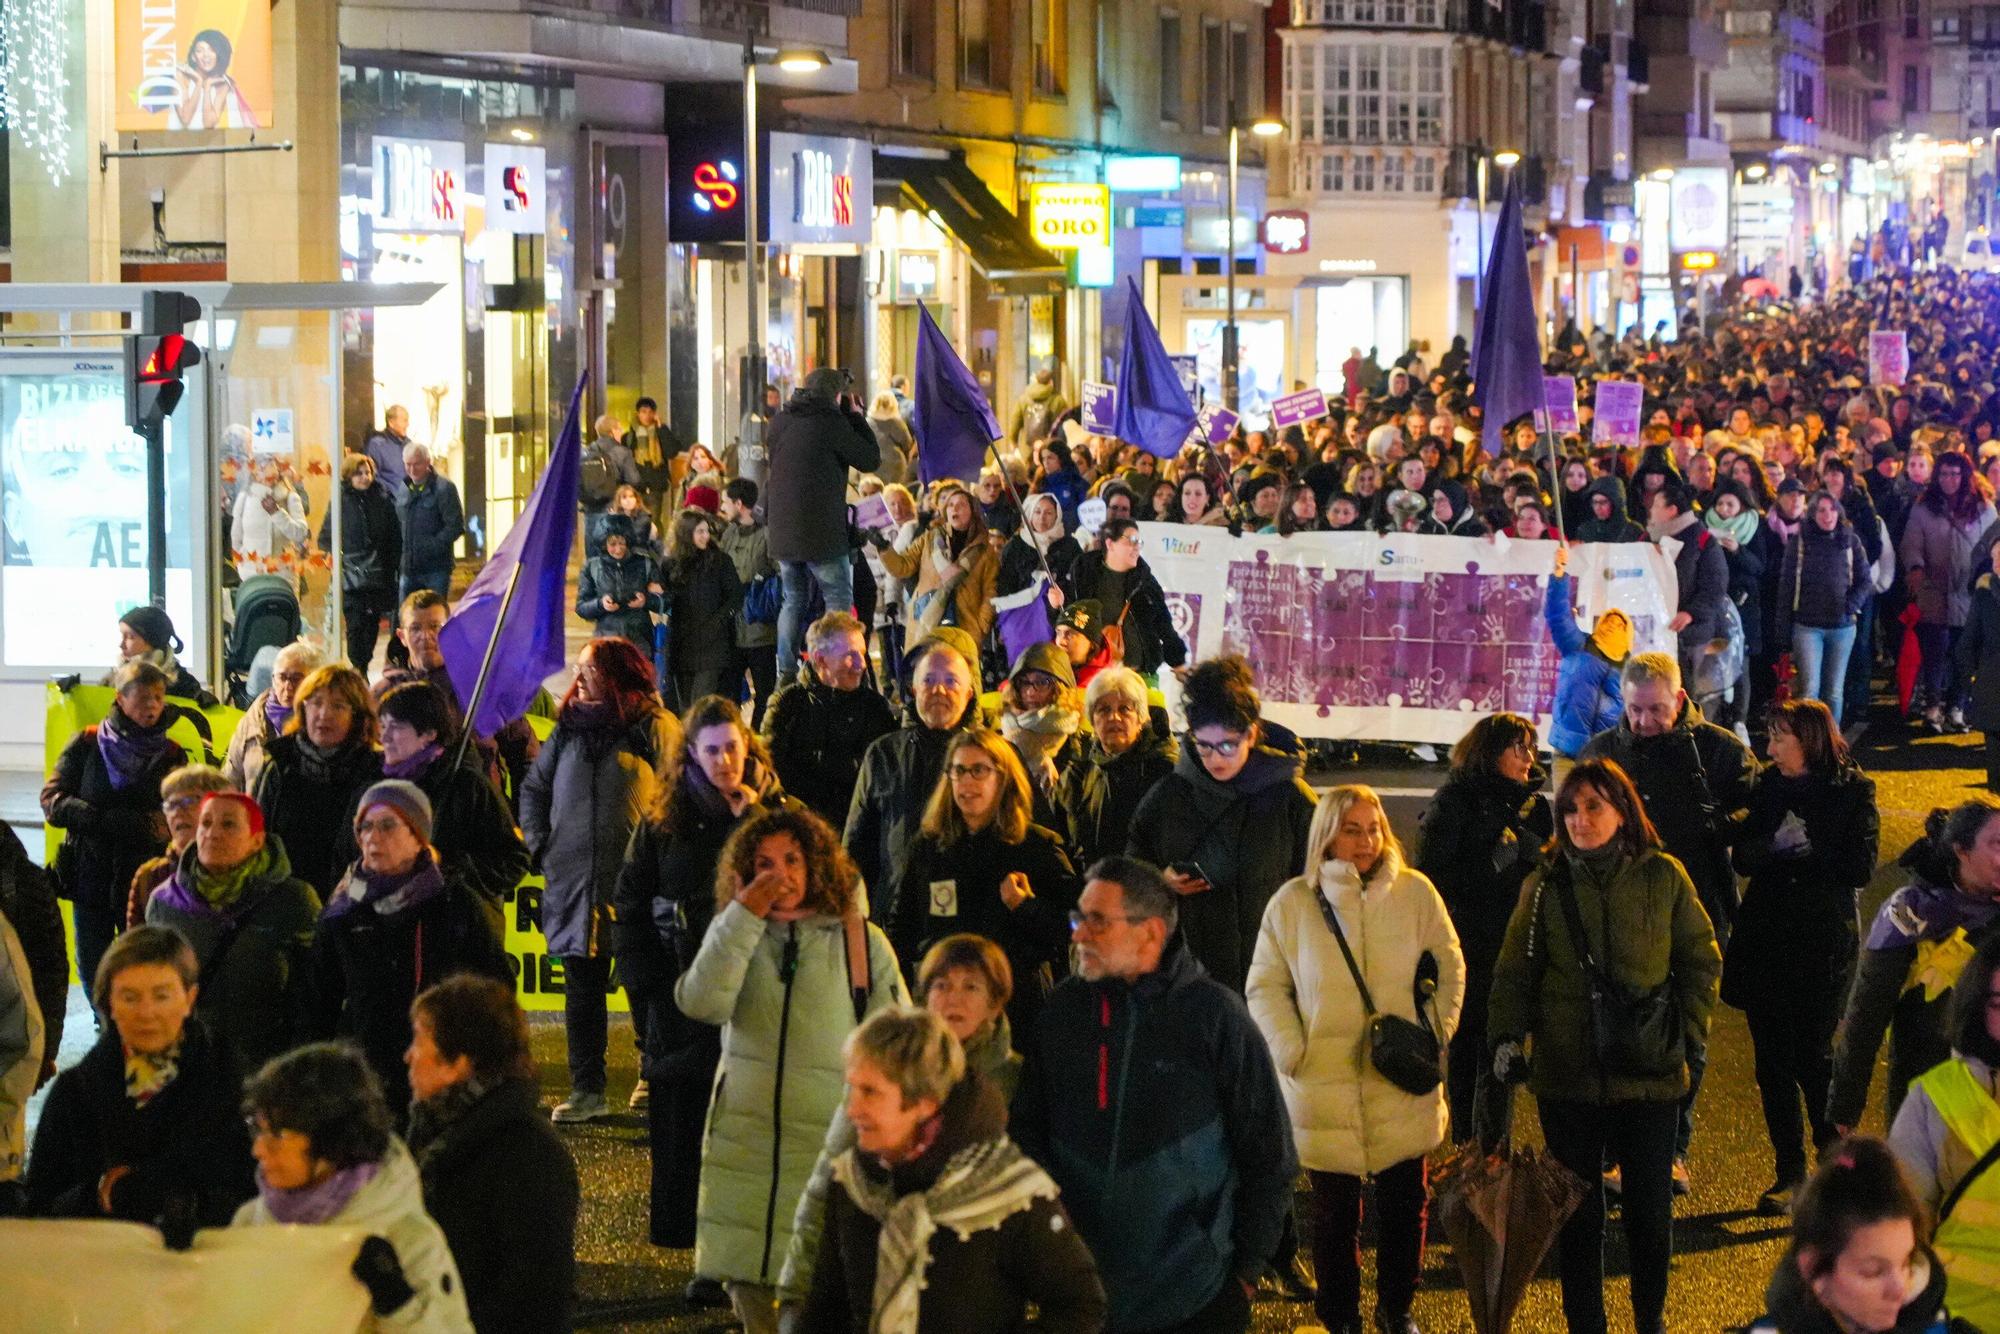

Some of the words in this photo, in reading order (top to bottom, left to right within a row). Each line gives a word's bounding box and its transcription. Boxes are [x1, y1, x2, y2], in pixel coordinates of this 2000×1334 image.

[802, 149, 852, 227] Bliss
[1043, 218, 1097, 235] ORO
[73, 362, 114, 371] JCDecaux
[20, 383, 80, 419] BIZI
[1161, 537, 1201, 554] Vital
